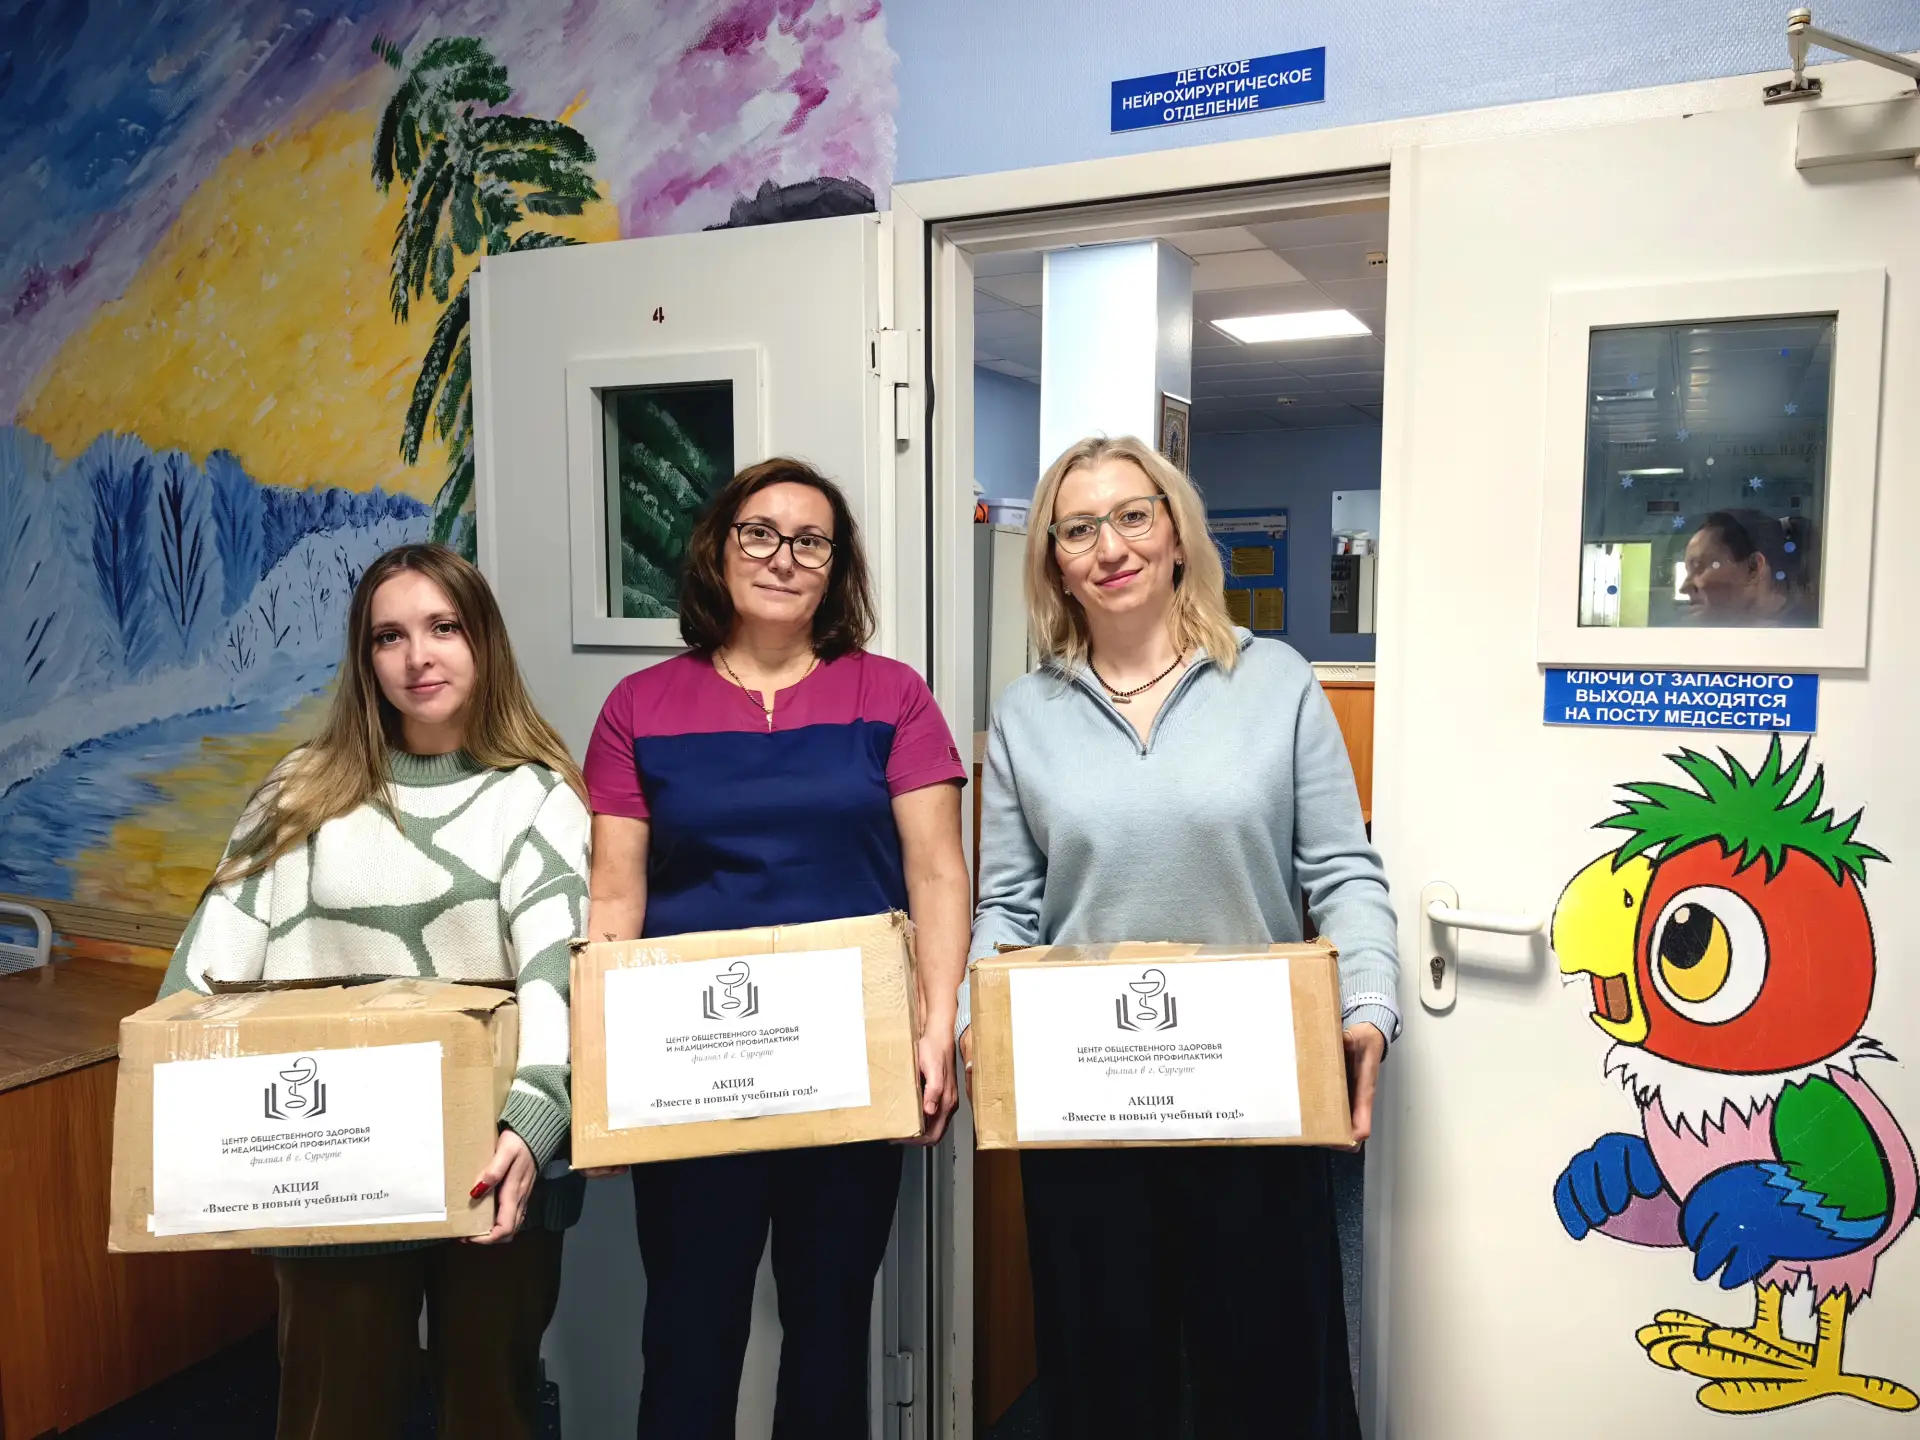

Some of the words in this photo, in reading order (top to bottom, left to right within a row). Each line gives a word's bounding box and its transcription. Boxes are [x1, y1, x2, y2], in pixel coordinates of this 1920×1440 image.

[1175, 60, 1250, 87] ДЕТСКОЕ
[1122, 67, 1312, 110] НЕЙРОХИРУРГИЧЕСКОЕ
[1163, 94, 1259, 121] ОТДЕЛЕНИЕ
[652, 306, 665, 324] 4
[1566, 670, 1634, 686] КЛЮЧИ
[1639, 672, 1666, 686] ОТ
[1671, 673, 1793, 689] ЗАПАСНОГО
[1575, 689, 1659, 706] ВЫХОДА
[1664, 691, 1786, 708] НАХОДЯТСЯ
[1564, 706, 1591, 721] НА
[1596, 708, 1660, 723] ПОСТУ
[1664, 710, 1791, 727] МЕДСЕСТРЫ
[665, 1035, 690, 1045] ЦЕНТР
[691, 1029, 757, 1042] ОБЩЕСТВЕННОГО
[759, 1026, 799, 1037] ЗДОРОВЬЯ
[674, 1039, 734, 1053] МЕДИЦИНСКОЙ
[1077, 1046, 1103, 1054] ЦЕНТР
[1104, 1044, 1176, 1053] ОБЩЕСТВЕННОГО
[1178, 1043, 1222, 1052] ЗДОРОВЬЯ
[1086, 1053, 1151, 1064] МЕДИЦИНСКОЙ
[1158, 1065, 1195, 1076] Сургуте
[711, 1077, 755, 1090] АКЦИЯ
[650, 1098, 692, 1108] «Вместе
[695, 1097, 701, 1105] в
[703, 1092, 739, 1104] новый
[742, 1088, 789, 1103] учебный
[792, 1085, 819, 1096] год!»
[1128, 1095, 1175, 1107] АКЦИЯ
[1062, 1112, 1107, 1122] «Вместе
[1109, 1113, 1116, 1121] в
[1119, 1110, 1157, 1121] новый
[1160, 1109, 1213, 1123] учебный
[1215, 1109, 1245, 1120] год!»
[221, 1136, 248, 1146] ЦЕНТР
[250, 1130, 324, 1144] ОБЩЕСТВЕННОГО
[326, 1126, 371, 1138] ЗДОРОВЬЯ
[230, 1141, 298, 1154] МЕДИЦИНСКОЙ
[299, 1136, 371, 1149] ПРОФИЛАКТИКИ
[304, 1150, 342, 1162] Сургуте
[272, 1181, 320, 1195] АКЦИЯ
[202, 1204, 249, 1214] «Вместе
[252, 1203, 259, 1211] в
[262, 1198, 301, 1210] новый
[304, 1192, 357, 1209] учебный
[360, 1190, 390, 1201] год!»
